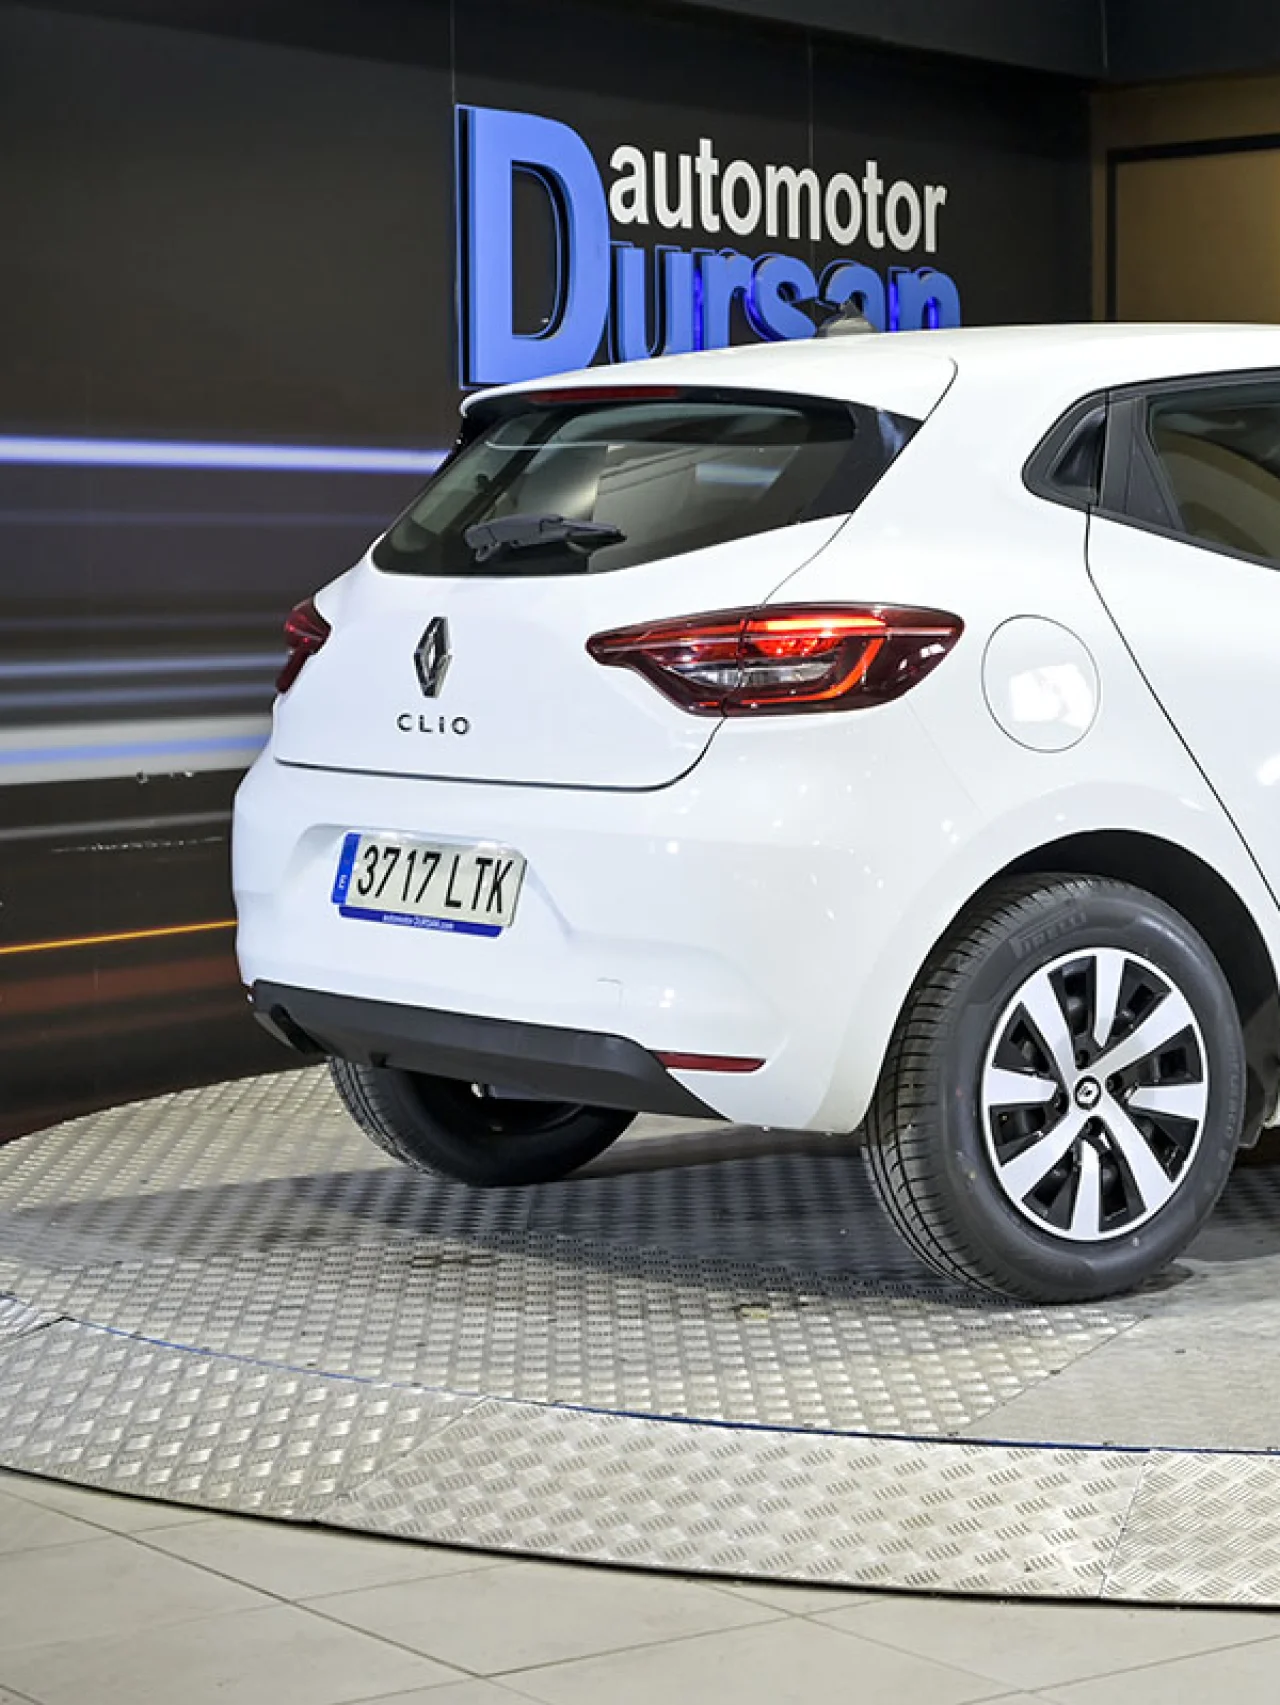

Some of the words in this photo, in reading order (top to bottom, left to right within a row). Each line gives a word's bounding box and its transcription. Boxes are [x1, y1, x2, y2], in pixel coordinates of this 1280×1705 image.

[609, 138, 947, 253] automotor
[397, 713, 471, 735] CLIO
[357, 844, 442, 903] 3717
[444, 853, 514, 914] LTK
